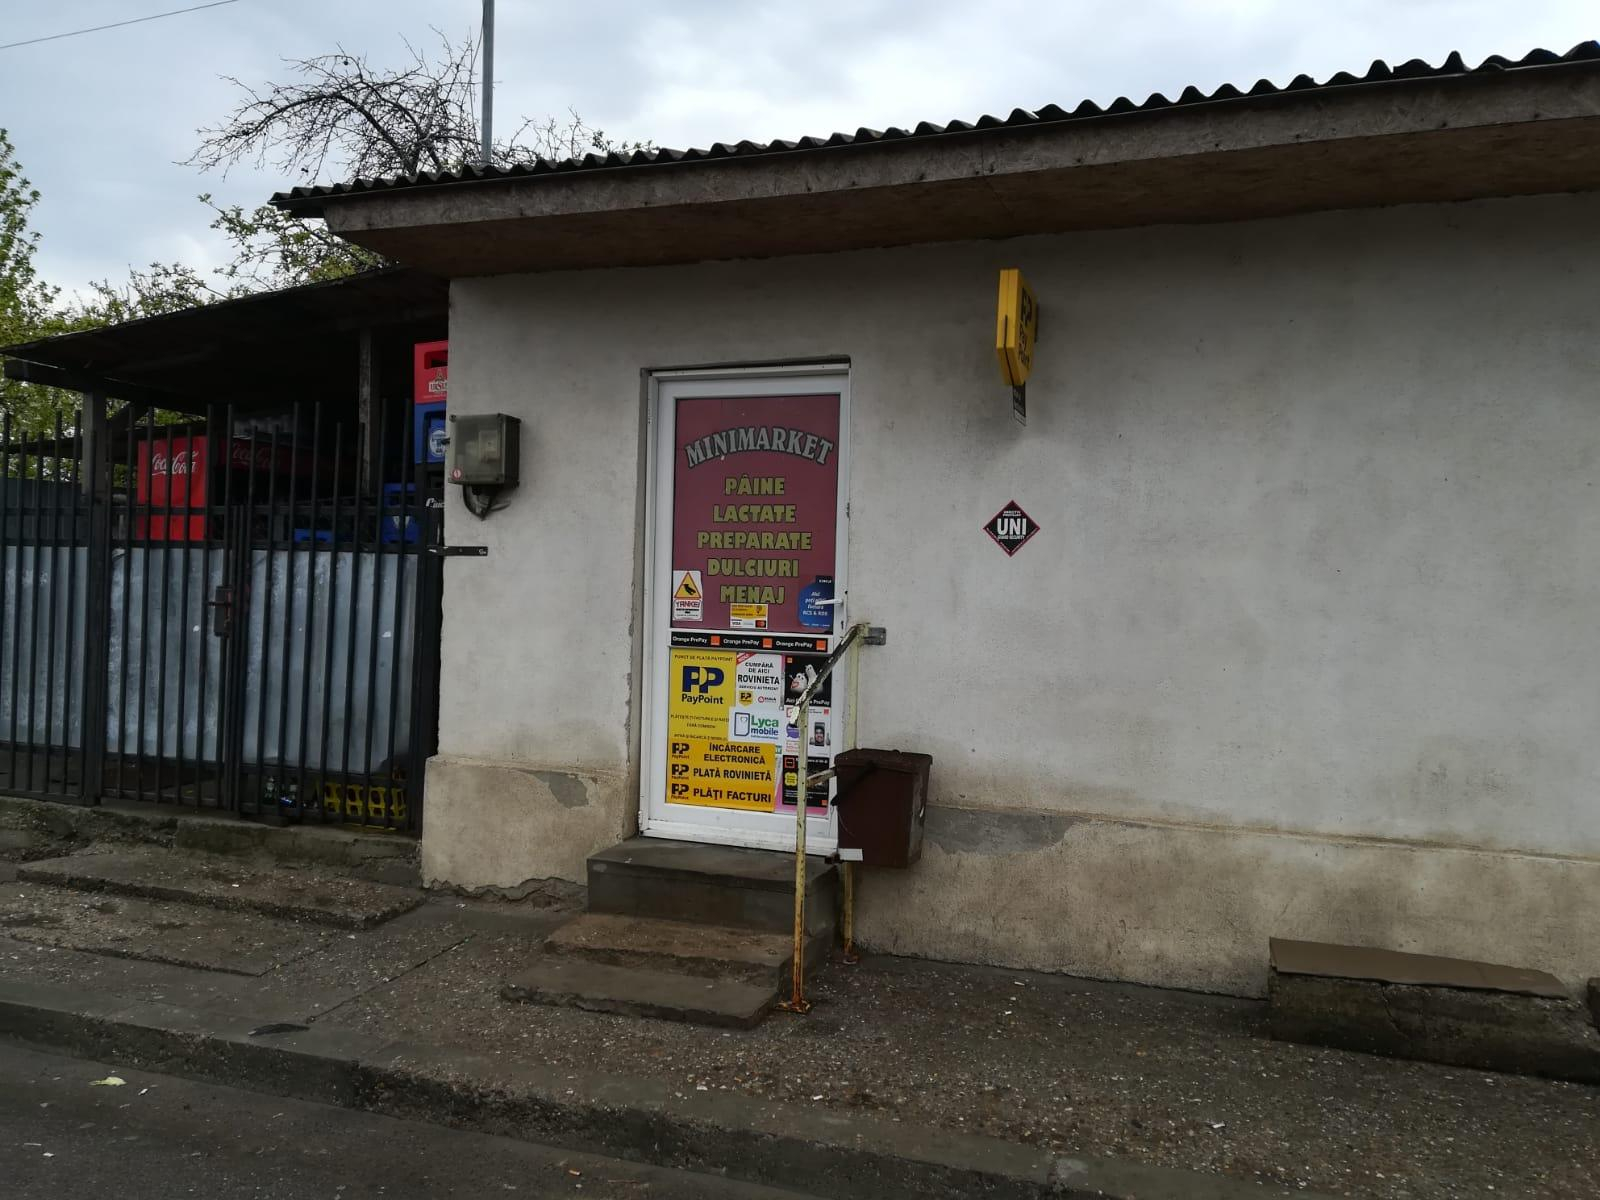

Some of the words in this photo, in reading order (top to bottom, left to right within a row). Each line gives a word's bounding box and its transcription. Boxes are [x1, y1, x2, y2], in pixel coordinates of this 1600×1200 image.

[685, 427, 835, 468] MINIMARKET
[725, 474, 785, 496] PÂINE
[713, 505, 796, 523] LACTATE
[997, 518, 1027, 536] UNI
[697, 531, 812, 550] PREPARATE
[707, 558, 800, 577] DULCIURI
[720, 585, 785, 604] MENAJ
[737, 674, 780, 684] ROVINIETA
[681, 693, 723, 704] PayPoint
[751, 715, 779, 728] Lyca
[751, 727, 779, 736] mobile
[709, 742, 761, 754] ÎNCĂRCARE
[704, 753, 766, 765] ELECTRONICĂ
[693, 767, 721, 778] PLATĂ
[723, 769, 772, 781] ROVINIETĂ
[727, 790, 772, 803] FACTURI
